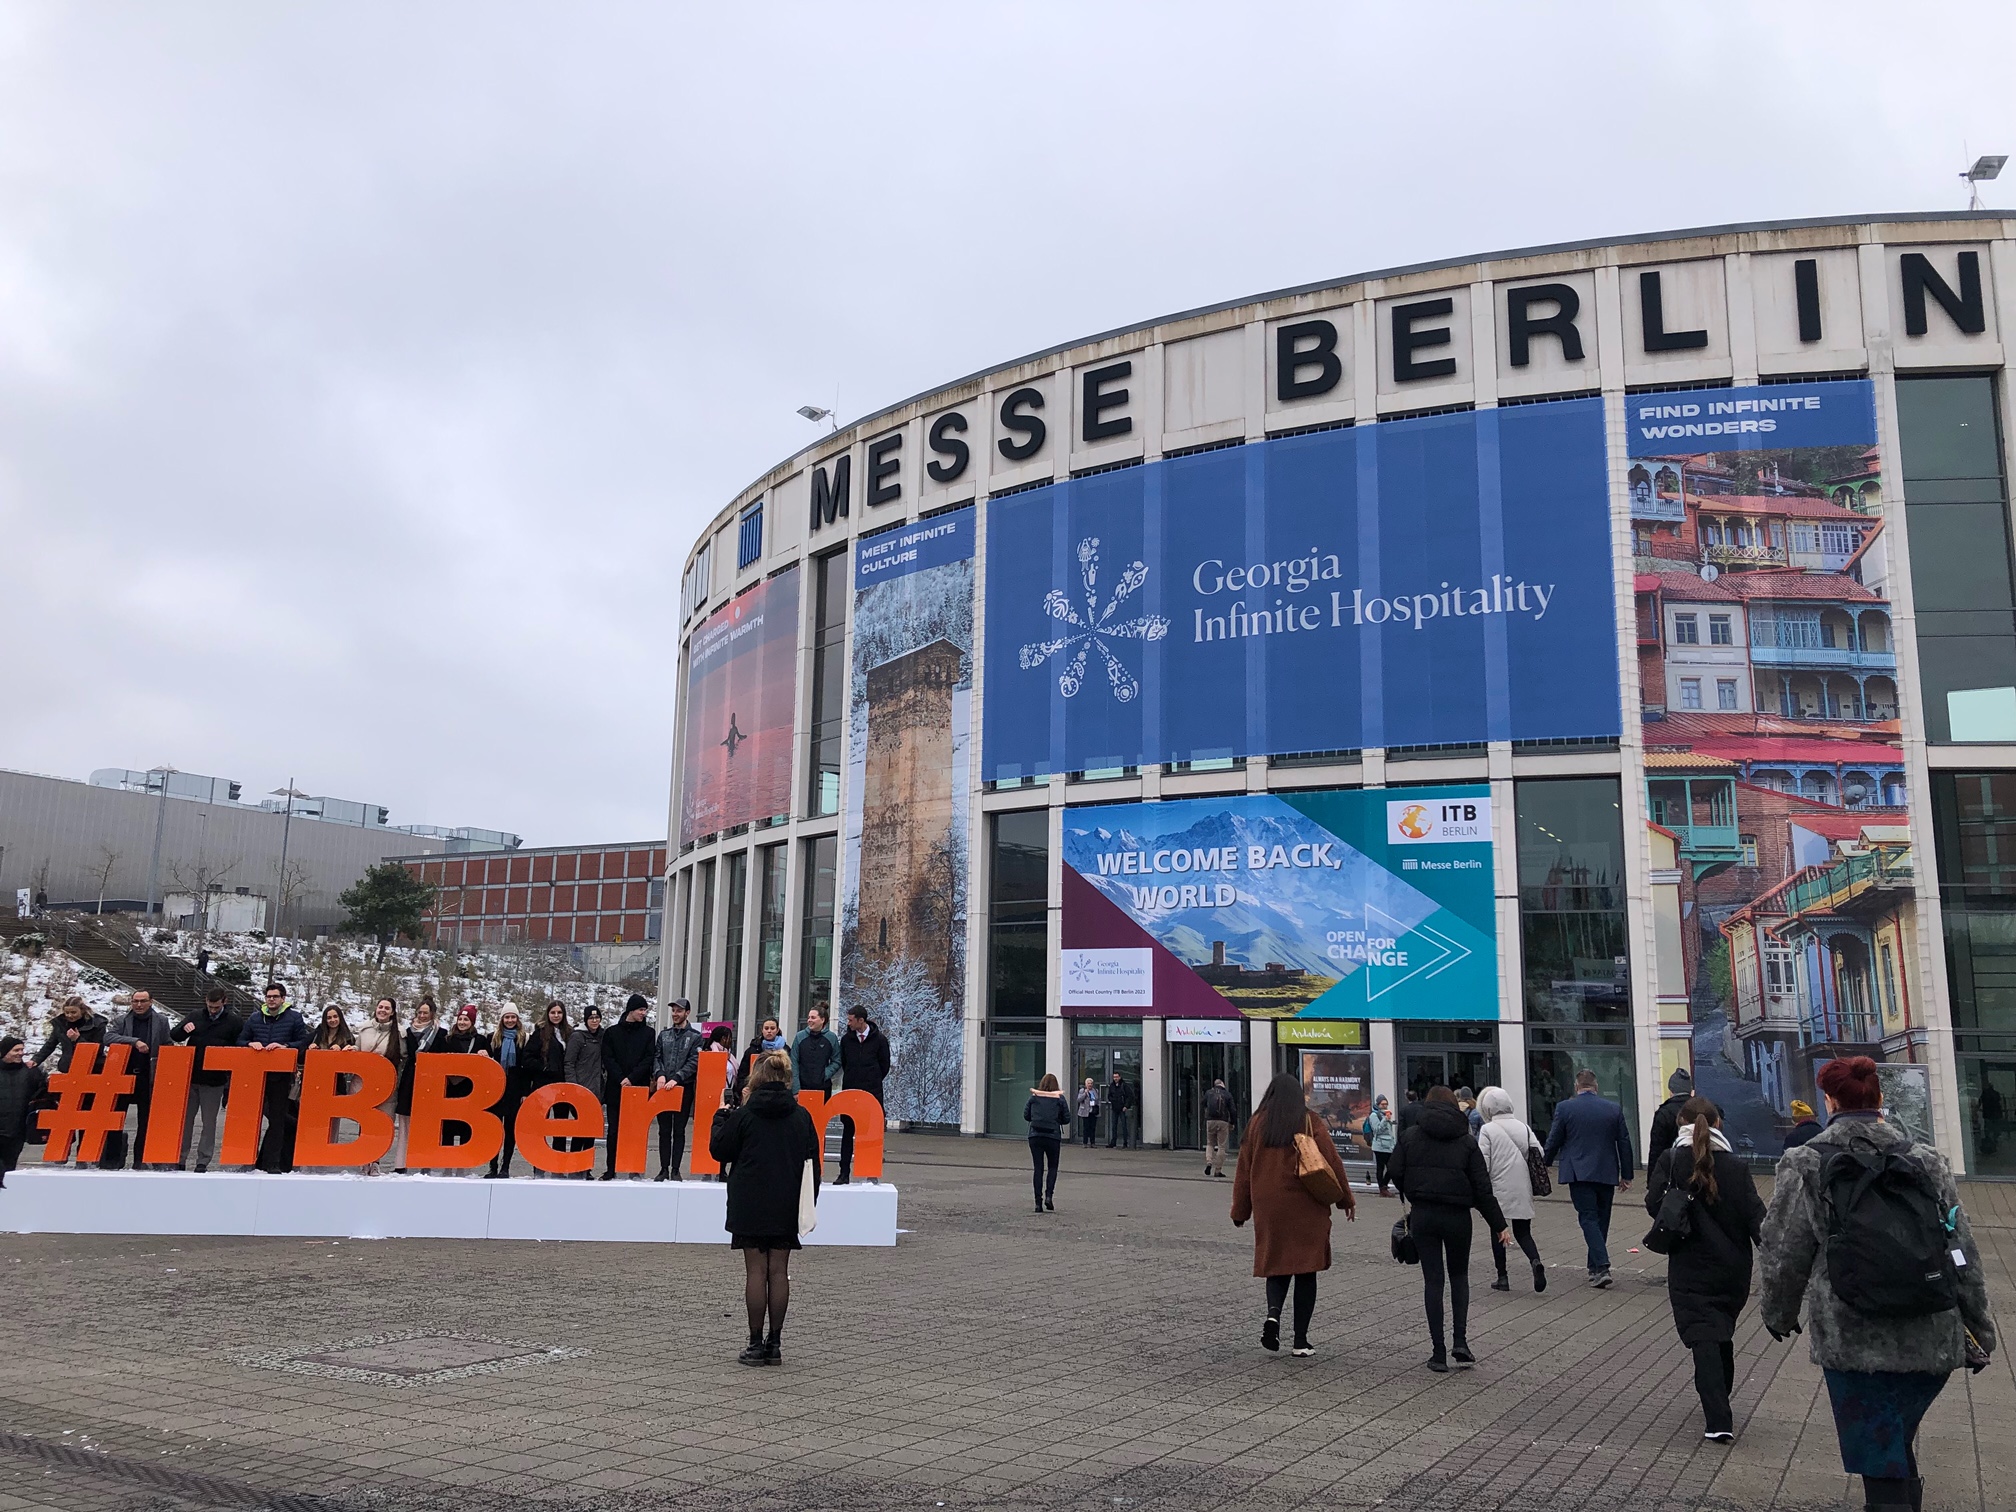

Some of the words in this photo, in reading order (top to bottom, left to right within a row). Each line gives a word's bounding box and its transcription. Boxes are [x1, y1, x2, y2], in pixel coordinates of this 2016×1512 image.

[810, 362, 1132, 529] MESSE
[1277, 251, 1985, 401] BERLIN
[1639, 403, 1700, 420] FIND
[1708, 396, 1821, 415] INFINITE
[1641, 419, 1777, 440] WONDERS
[861, 538, 896, 559] MEET
[899, 522, 957, 549] INFINITE
[861, 549, 917, 576] CULTURE
[1193, 546, 1342, 595] Georgia
[1194, 599, 1321, 643] Infinite
[1331, 574, 1555, 631] Hospitality
[692, 651, 705, 669] WITH
[704, 634, 729, 659] INFINITE
[730, 614, 764, 642] WARMTH
[693, 638, 702, 654] GET
[702, 619, 729, 646] CHARGED
[1442, 804, 1477, 822] ITB
[1442, 826, 1478, 837] BERLIN
[1097, 846, 1238, 876] WELCOME
[1247, 842, 1342, 871] BACK,
[1421, 861, 1451, 870] Messe
[1453, 859, 1482, 869] Berlin
[1133, 883, 1237, 911] WORLD
[1326, 931, 1365, 943] OPEN
[1367, 938, 1396, 949] FOR
[1097, 960, 1119, 968] Georgia
[1326, 944, 1409, 967] CHANGE
[1116, 968, 1145, 976] Hospitality
[1176, 1025, 1213, 1037] Andalucía
[1291, 1027, 1334, 1039] Andalucía
[36, 1041, 884, 1177] #ITBBerln
